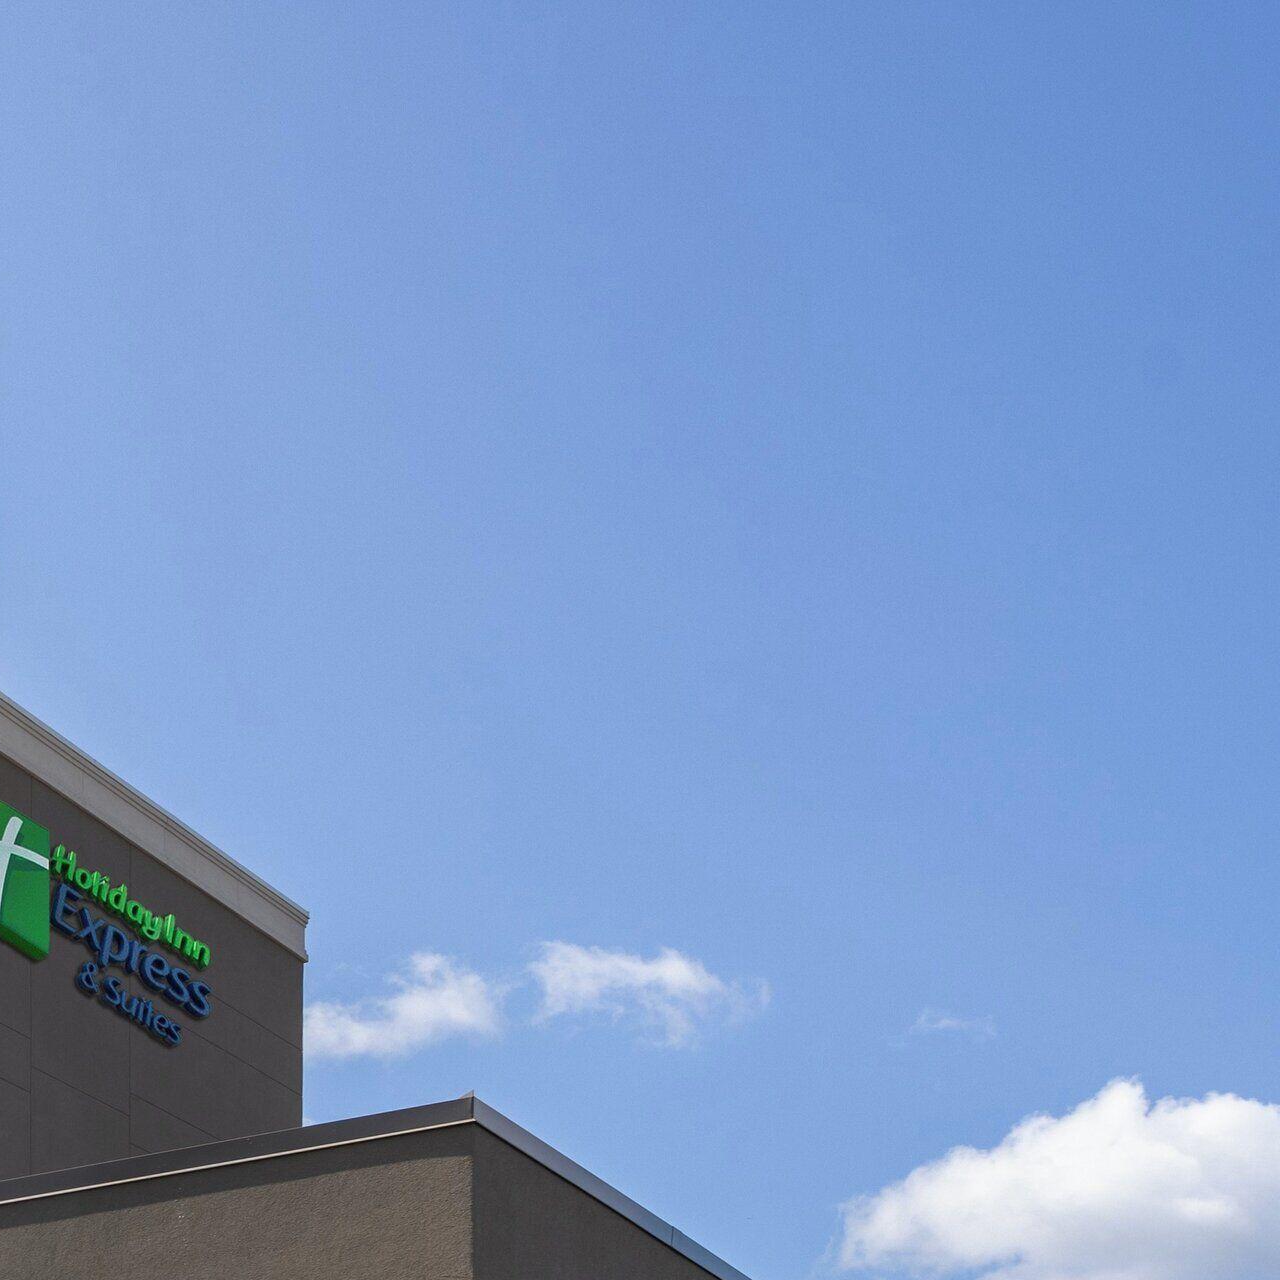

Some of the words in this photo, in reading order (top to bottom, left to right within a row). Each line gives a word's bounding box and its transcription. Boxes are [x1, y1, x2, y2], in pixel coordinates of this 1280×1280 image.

[51, 883, 213, 1018] Express
[52, 844, 163, 940] Holiday
[164, 913, 211, 970] Inn
[75, 961, 99, 996] &
[101, 975, 183, 1045] Suites
